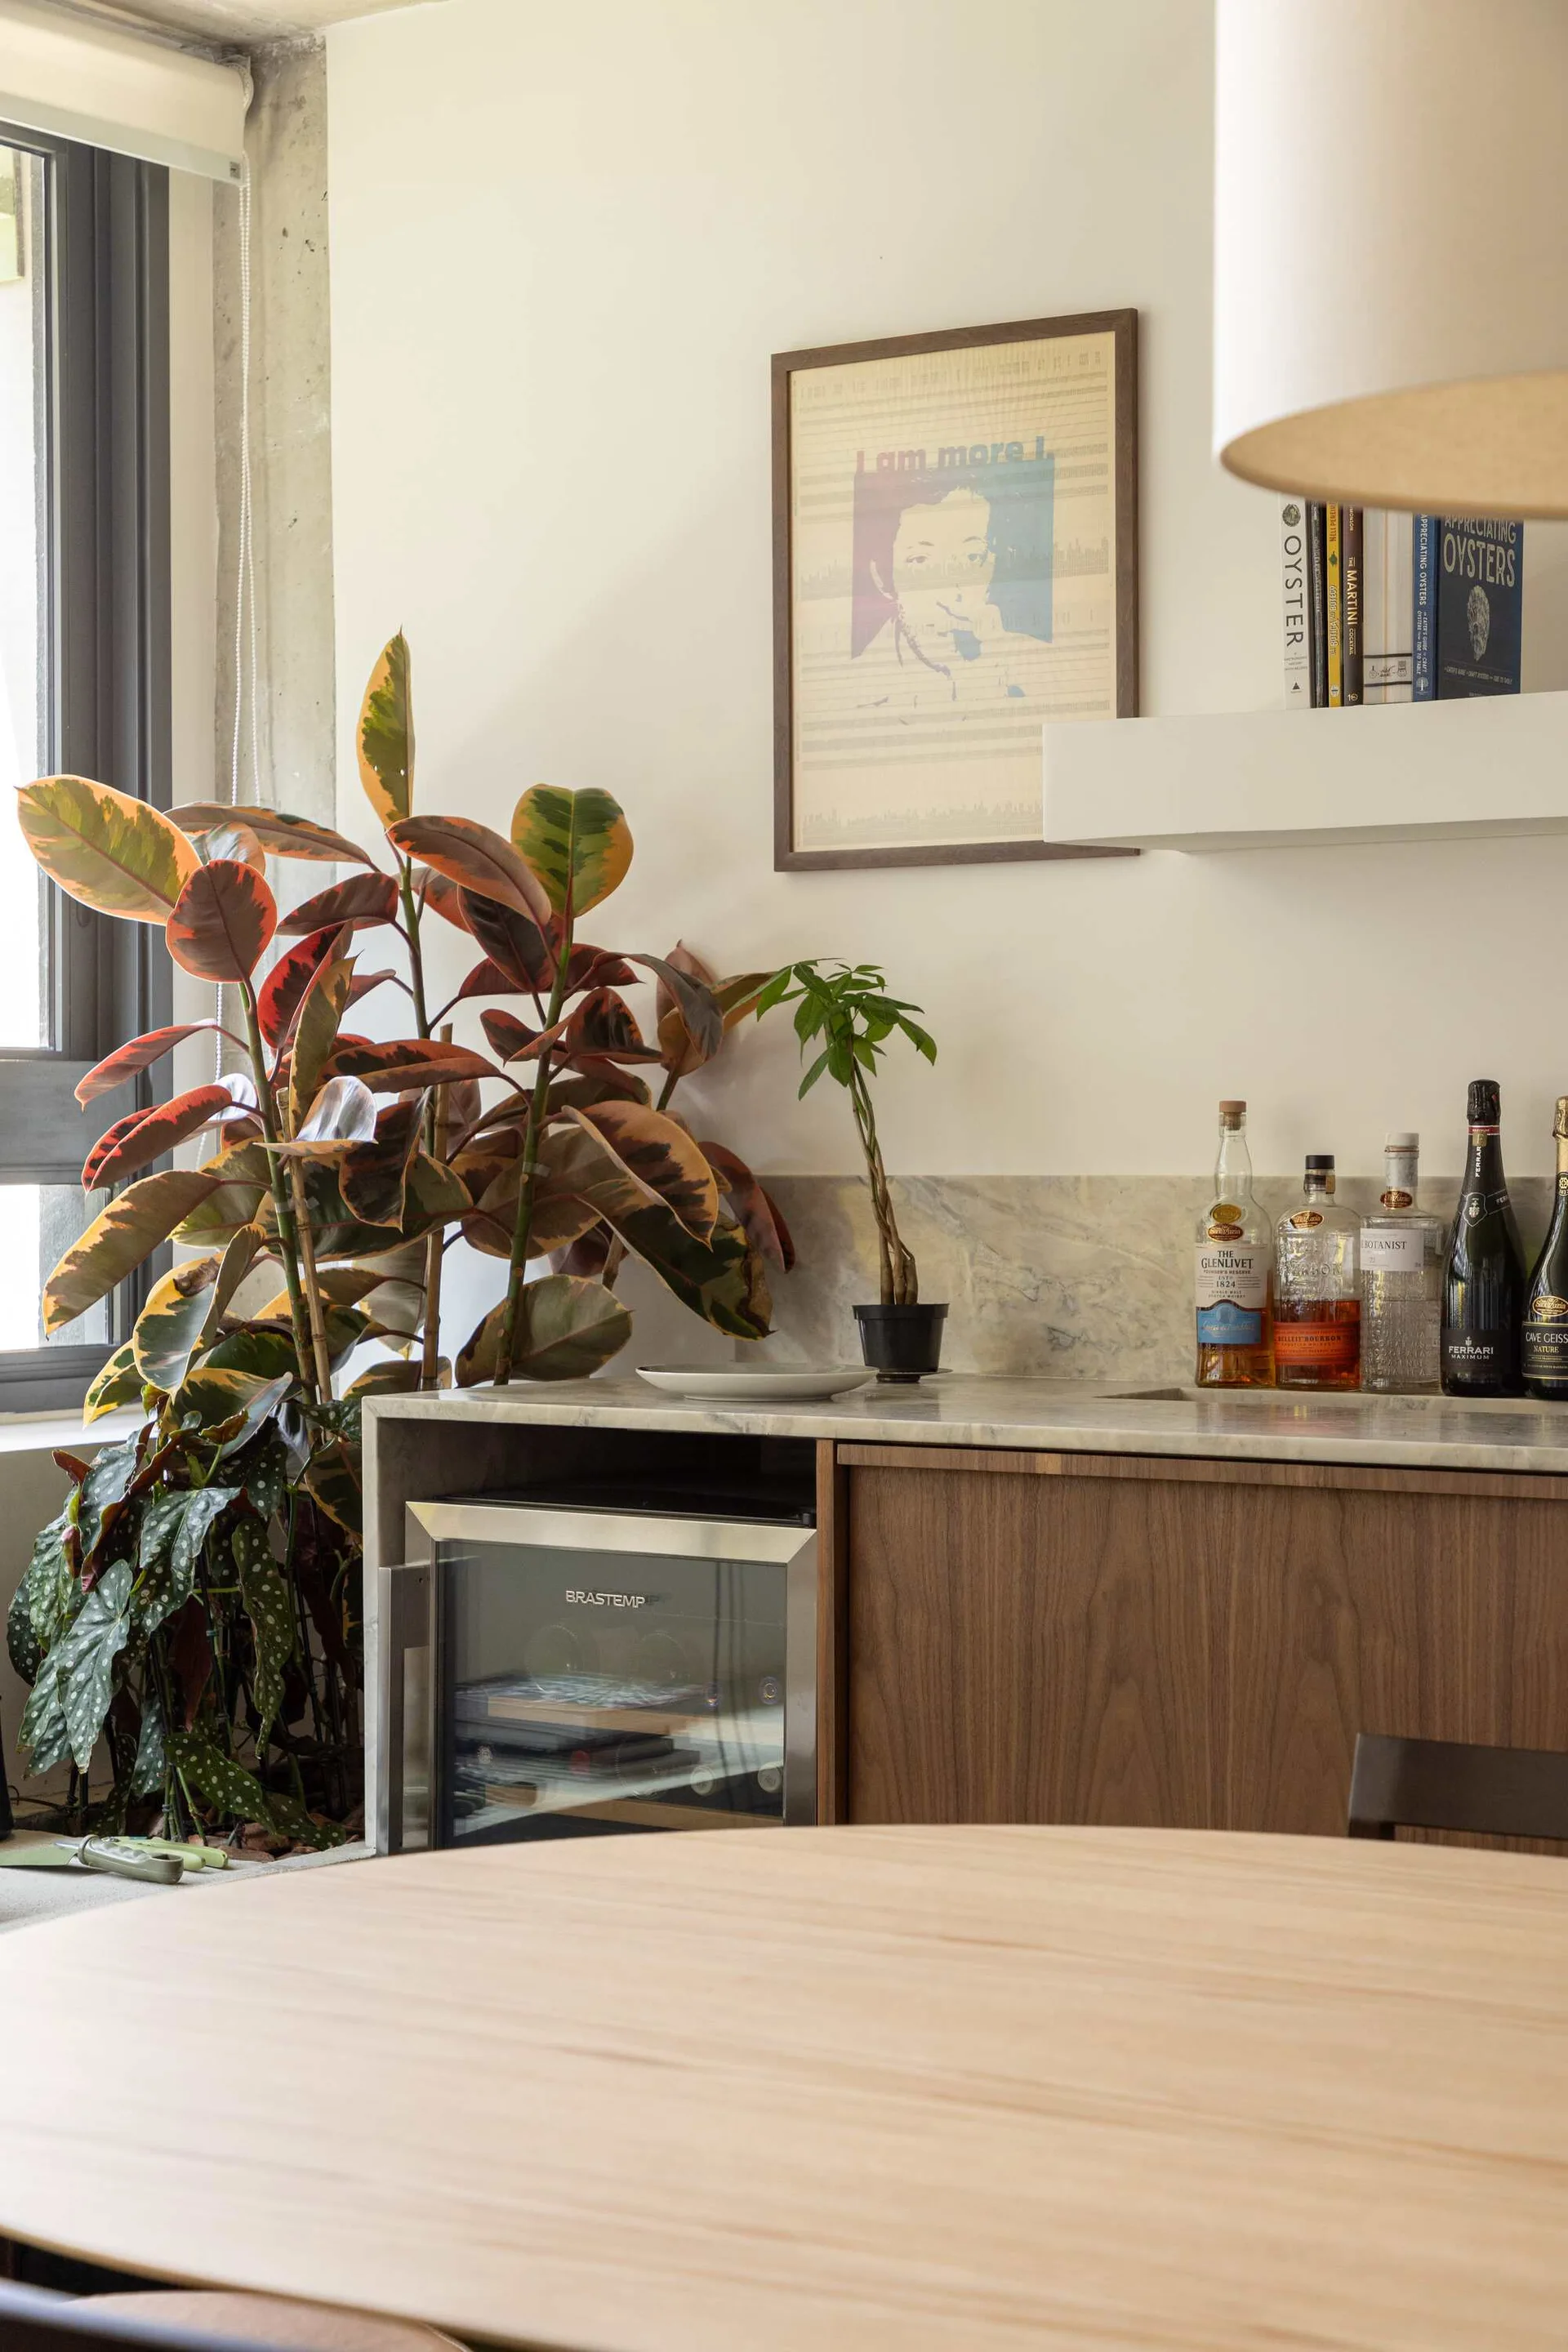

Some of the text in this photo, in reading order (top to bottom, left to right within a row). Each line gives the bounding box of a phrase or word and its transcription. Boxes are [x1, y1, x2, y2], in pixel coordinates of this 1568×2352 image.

[876, 448, 926, 472] am
[938, 441, 1024, 468] more
[1419, 514, 1428, 605] APPRECIATING OYSTERS
[1443, 532, 1516, 587] OYSTERS
[1285, 535, 1304, 647] OYSTER
[1347, 570, 1358, 625] MARTINI
[1364, 1241, 1408, 1250] BOTANIST
[1217, 1250, 1234, 1258] THE
[1201, 1258, 1254, 1269] GLENLIVET
[1526, 1331, 1542, 1343] CAVE
[1448, 1346, 1494, 1355] FERRARI
[1533, 1345, 1560, 1353] NATURE
[565, 1590, 646, 1609] BRASTEMP
